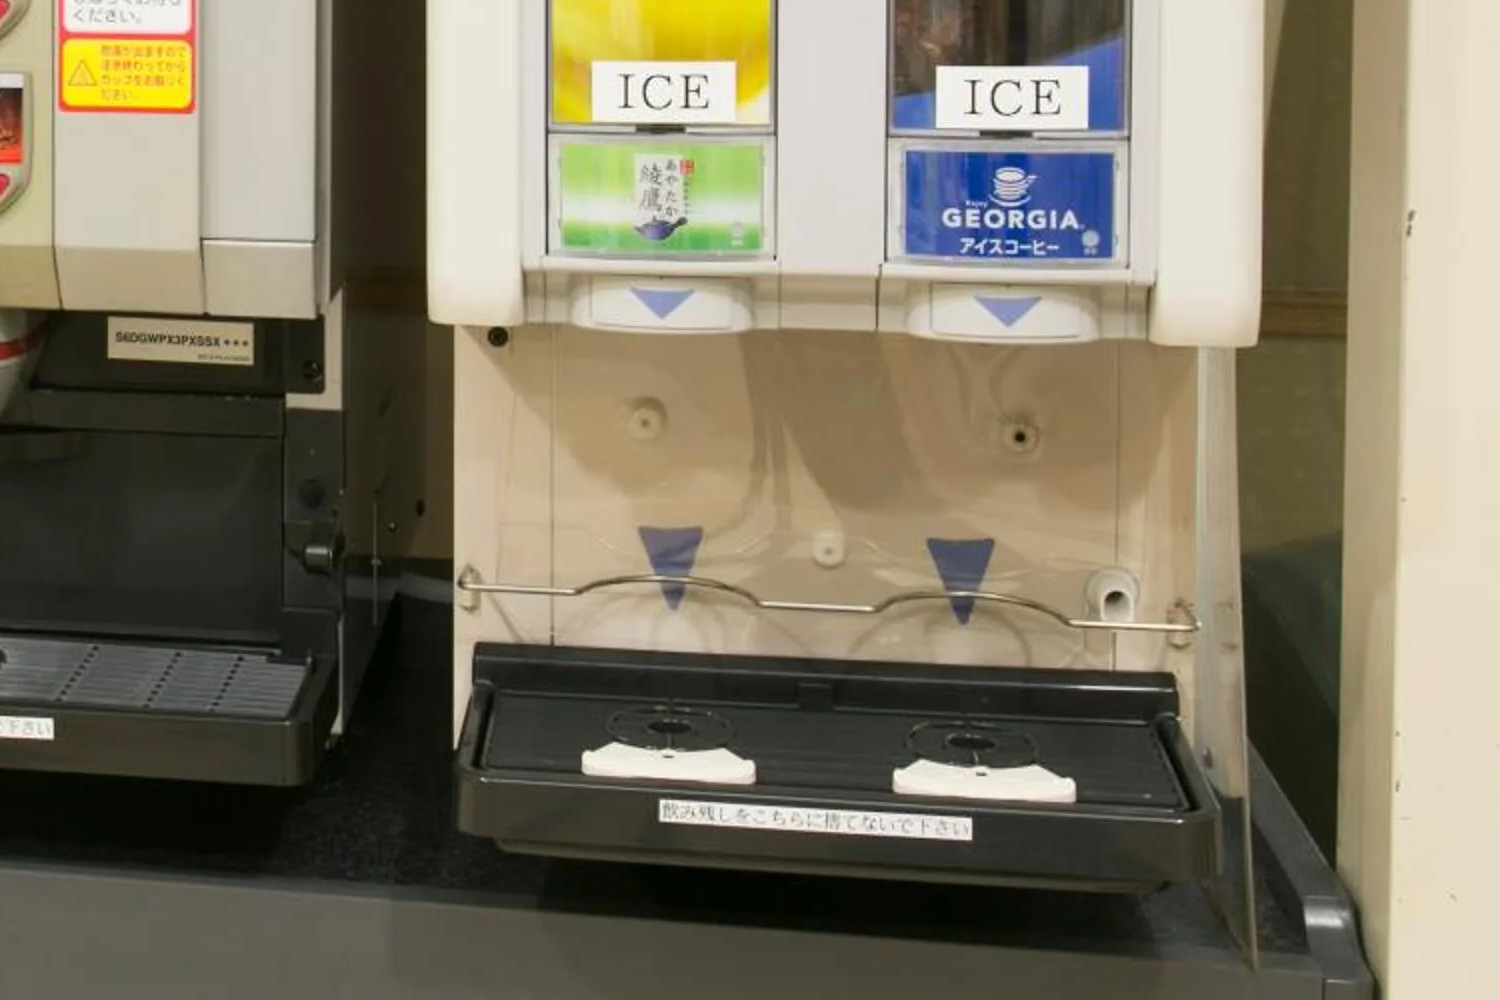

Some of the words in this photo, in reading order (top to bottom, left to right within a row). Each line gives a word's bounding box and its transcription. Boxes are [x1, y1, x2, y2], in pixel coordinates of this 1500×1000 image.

[617, 73, 710, 110] ICE
[963, 79, 1062, 116] ICE
[942, 208, 1079, 229] GEORGIA
[960, 237, 1060, 255] アイスコーヒー
